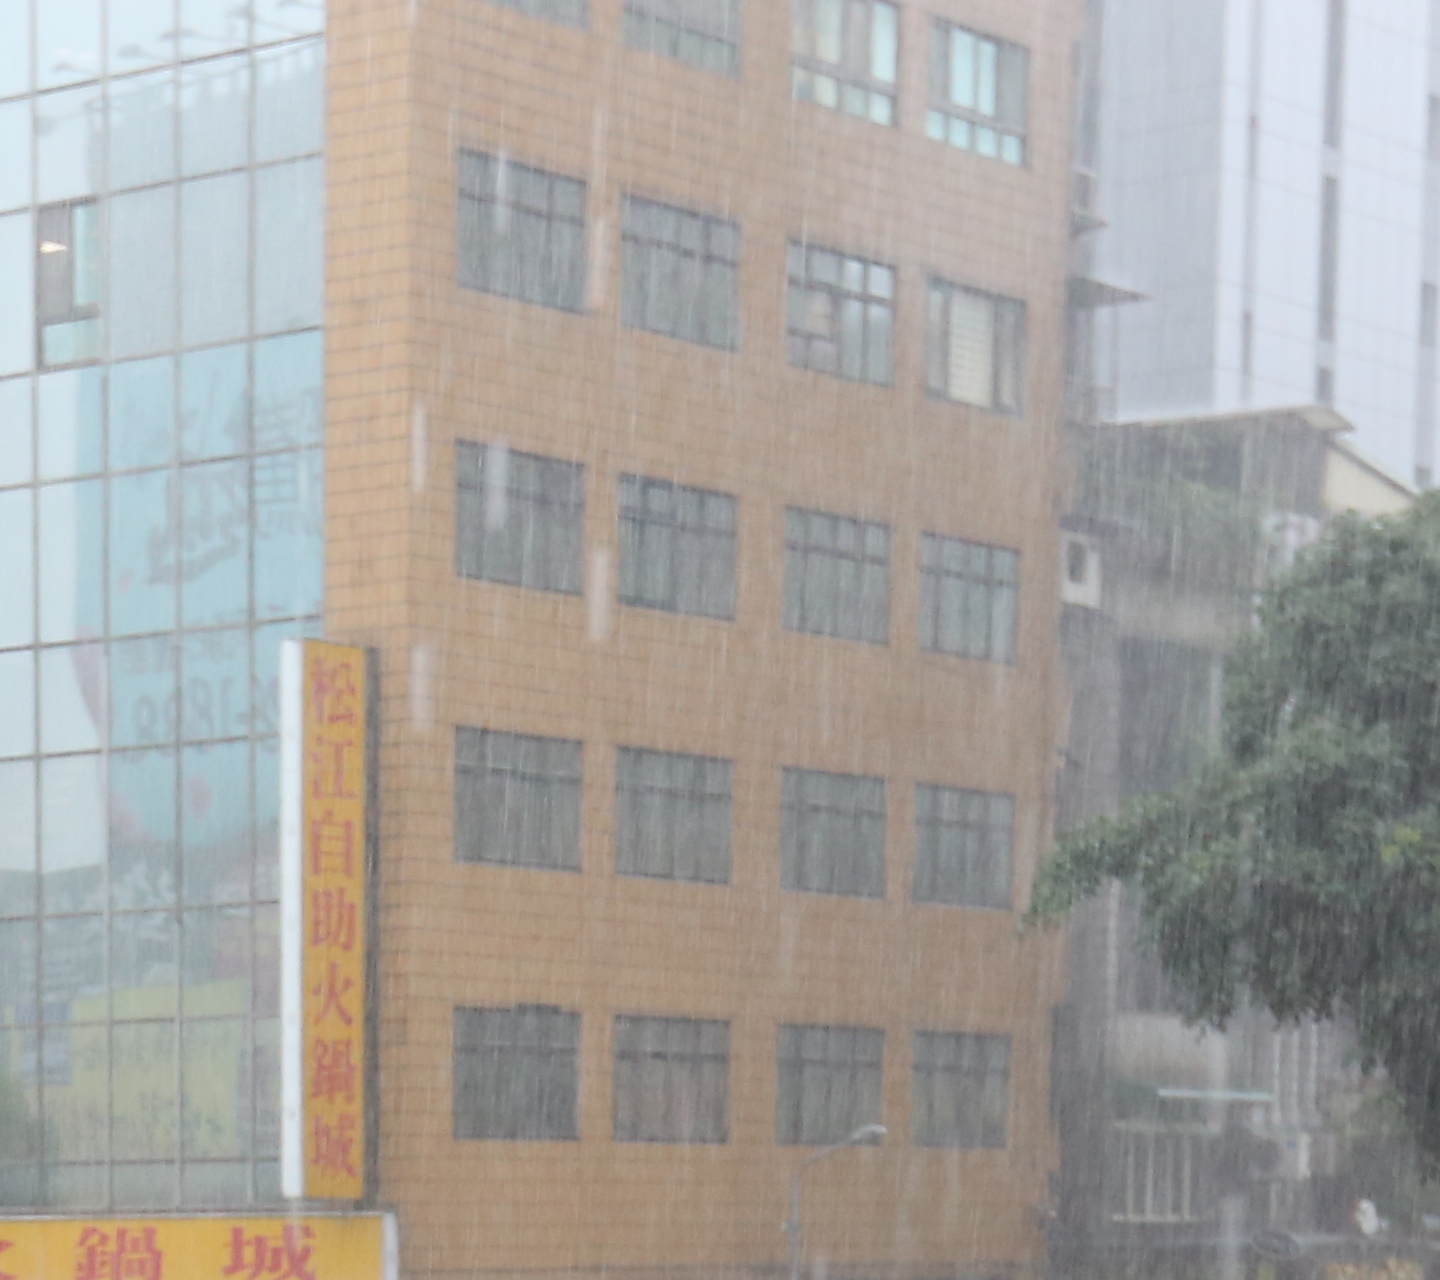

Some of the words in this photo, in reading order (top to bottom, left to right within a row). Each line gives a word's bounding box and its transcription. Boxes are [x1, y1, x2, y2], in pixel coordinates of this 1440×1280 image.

[310, 658, 360, 1179] 松江自助火鍋城
